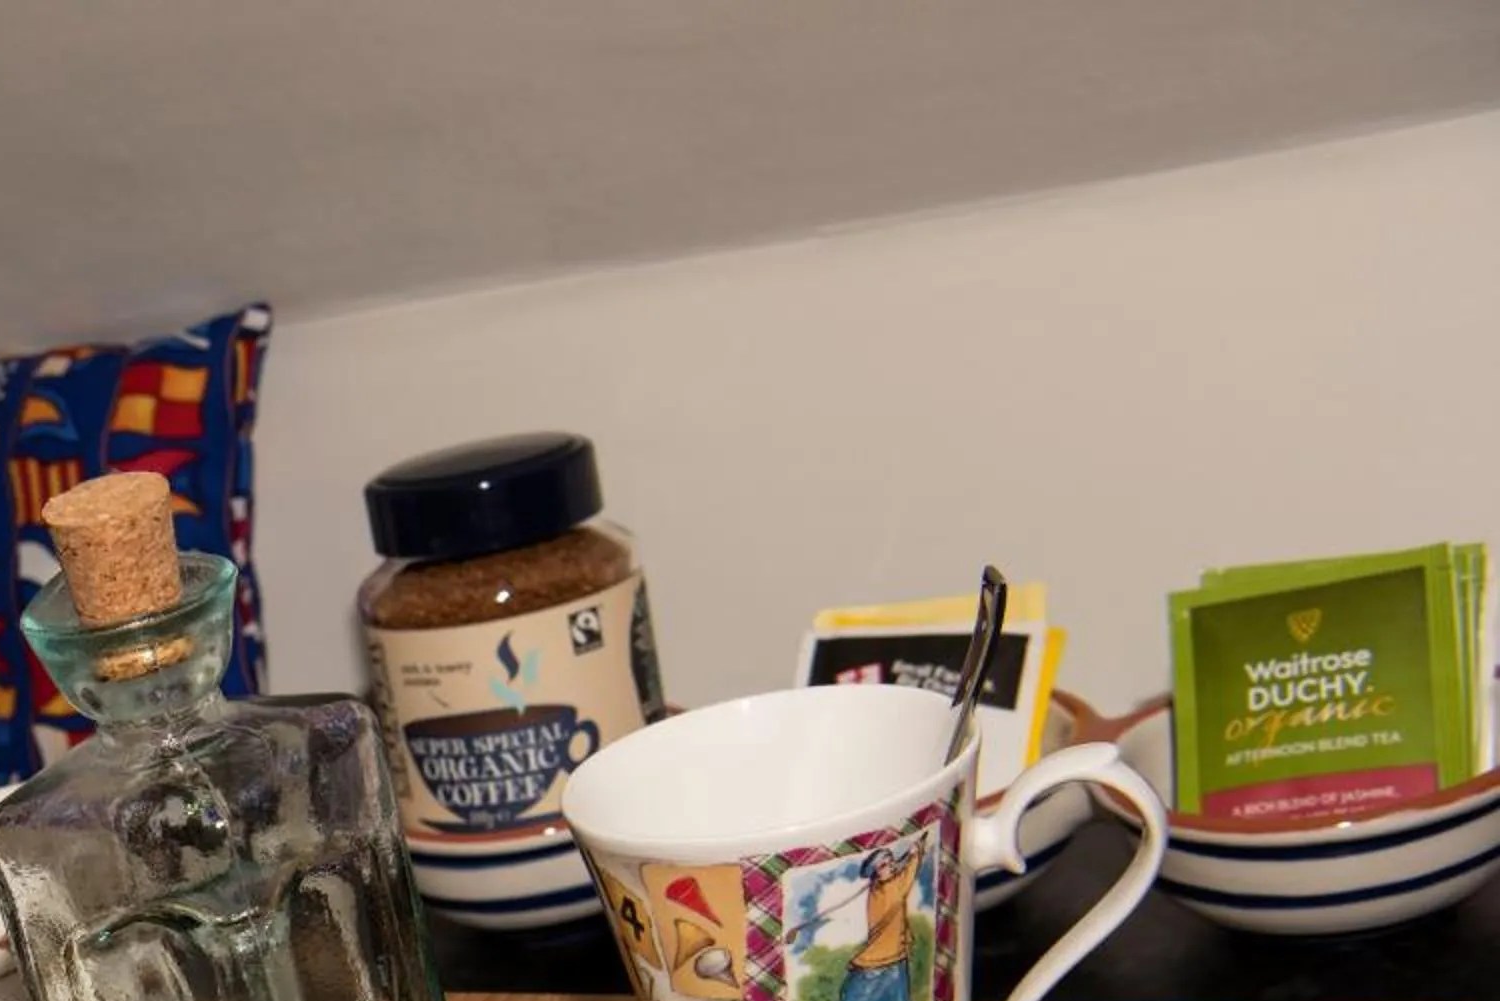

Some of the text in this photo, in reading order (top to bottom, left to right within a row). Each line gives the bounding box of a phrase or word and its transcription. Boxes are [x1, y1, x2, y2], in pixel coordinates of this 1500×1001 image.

[1245, 648, 1372, 682] Waitrose
[1248, 671, 1368, 712] DUCHY
[409, 722, 569, 757] SUPER SPECIAL
[1224, 693, 1395, 763] organic
[423, 746, 561, 781] ORGANIC
[1226, 731, 1402, 766] AFTERNOON BLEND TEA
[437, 774, 545, 806] COFFEE
